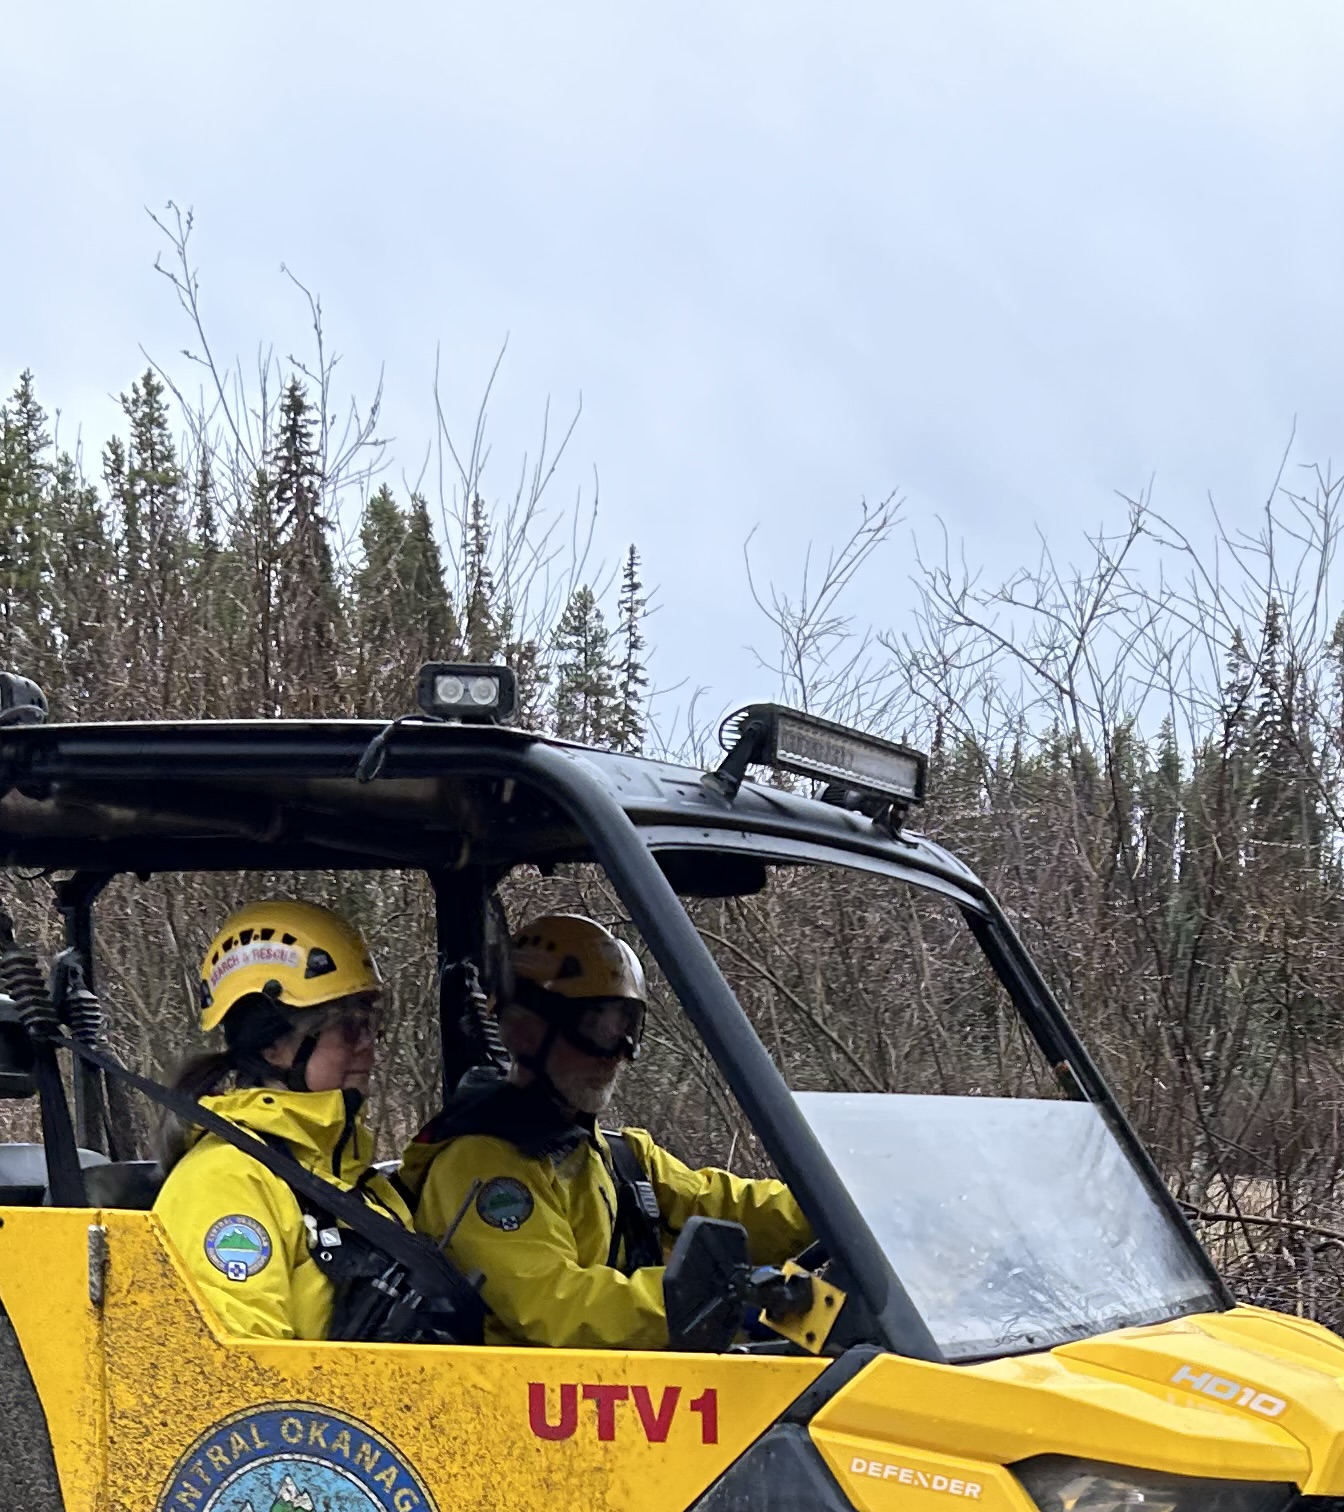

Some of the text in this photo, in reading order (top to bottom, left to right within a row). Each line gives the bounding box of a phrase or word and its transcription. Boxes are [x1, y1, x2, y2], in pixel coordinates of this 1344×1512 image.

[528, 1382, 719, 1445] UTV1
[1171, 1365, 1287, 1417] HD10
[850, 1457, 982, 1499] DEFENDER
